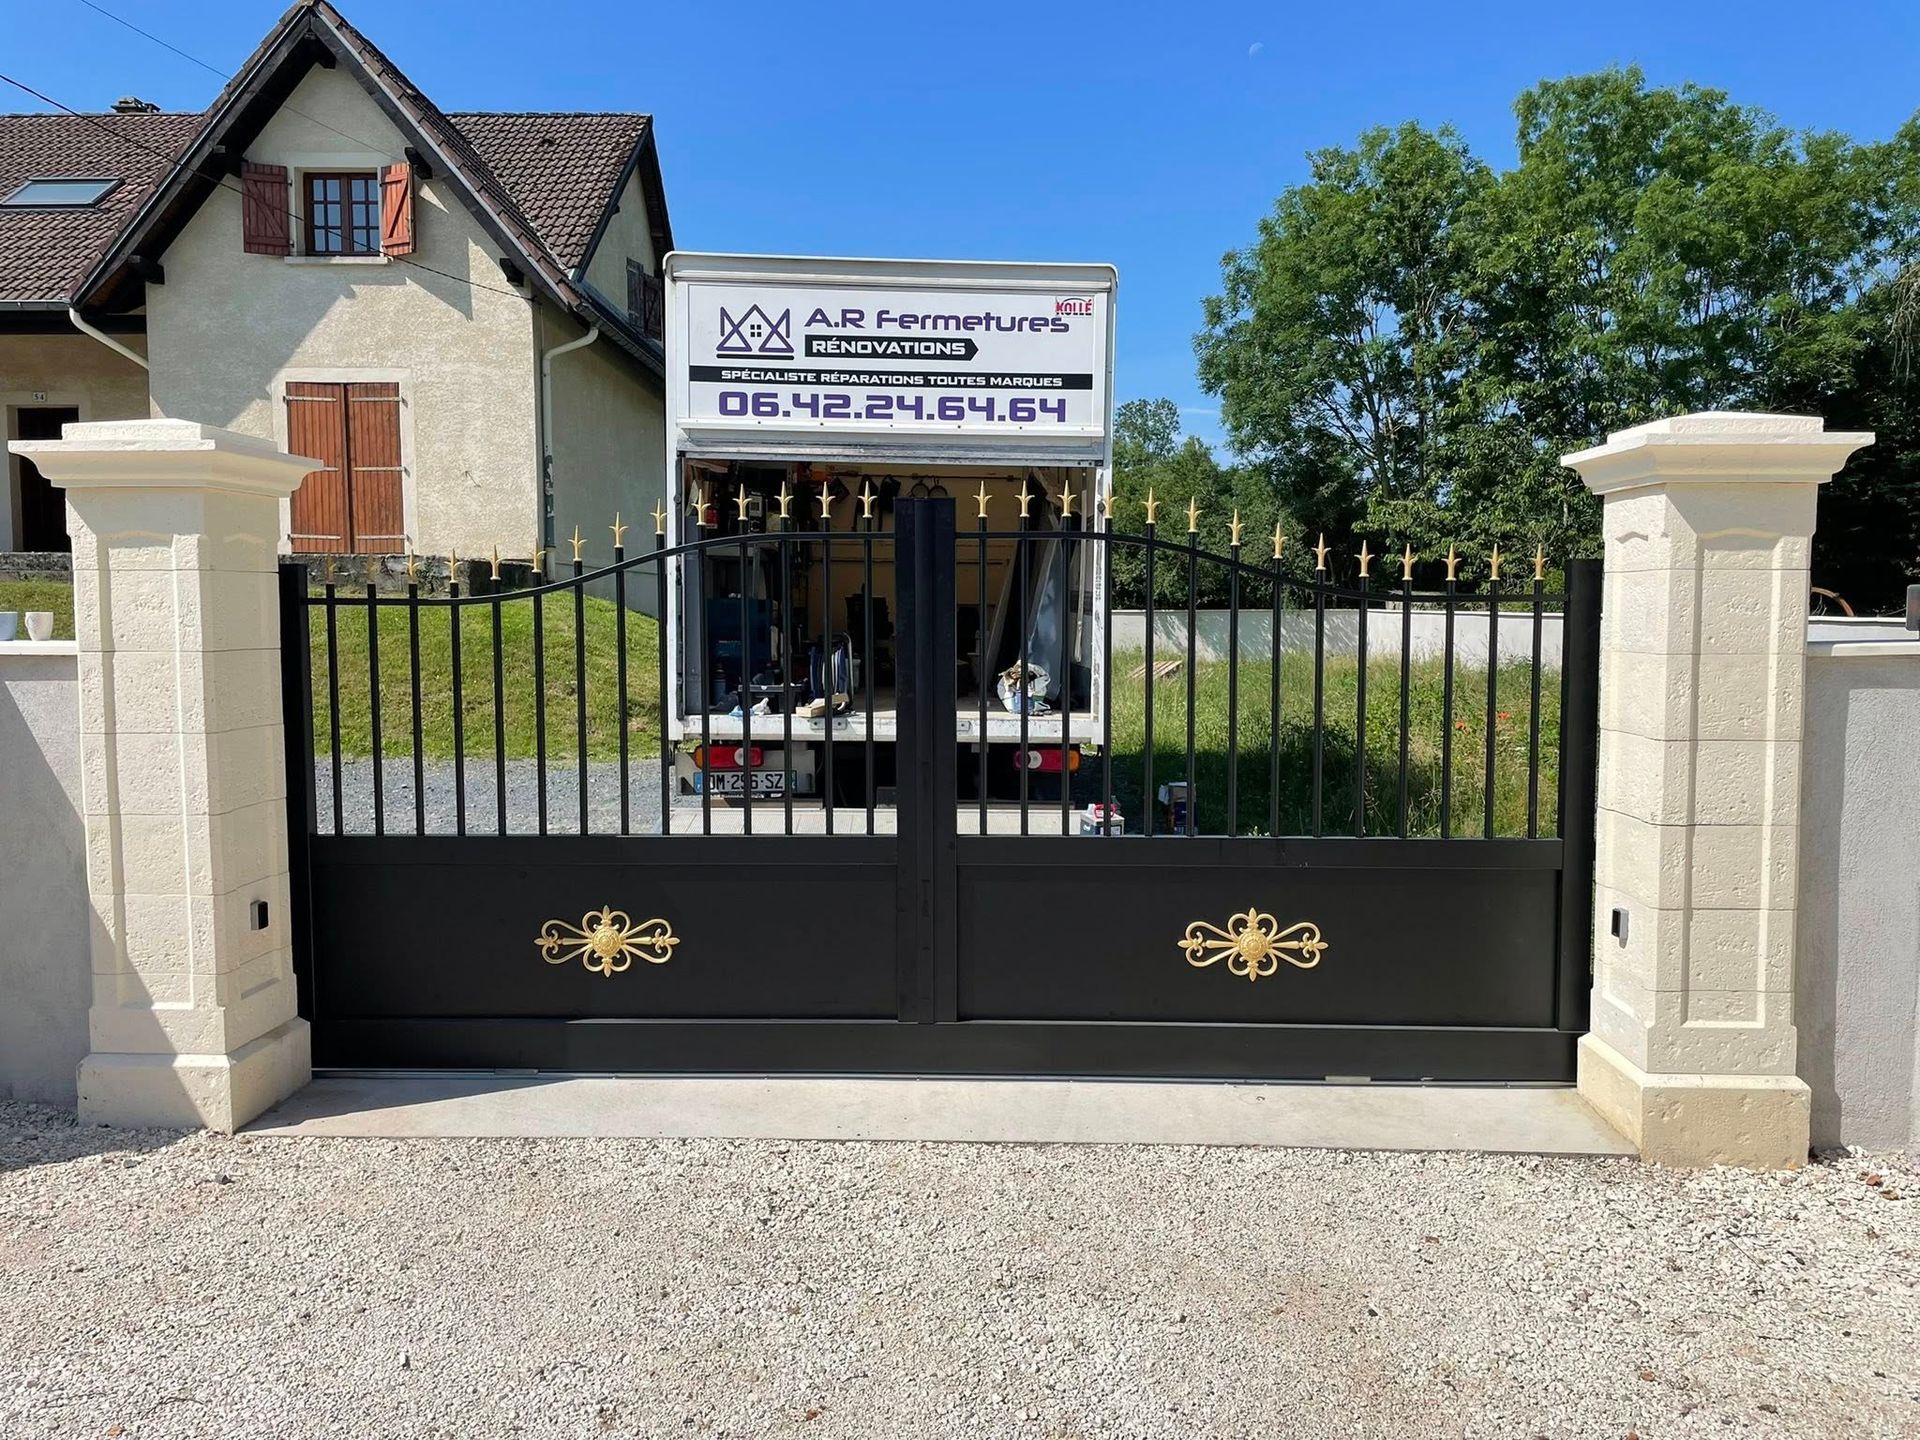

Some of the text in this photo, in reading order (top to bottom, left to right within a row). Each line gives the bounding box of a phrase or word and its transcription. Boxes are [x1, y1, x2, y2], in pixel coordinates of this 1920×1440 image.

[804, 308, 1069, 333] A.R Fermetures
[812, 337, 966, 356] RÉNOVATIONS
[721, 369, 1063, 387] SPÉCIALISTE RÉPARATIONS TOUTES MARQUES
[718, 391, 1066, 423] 06.42.24.64.64
